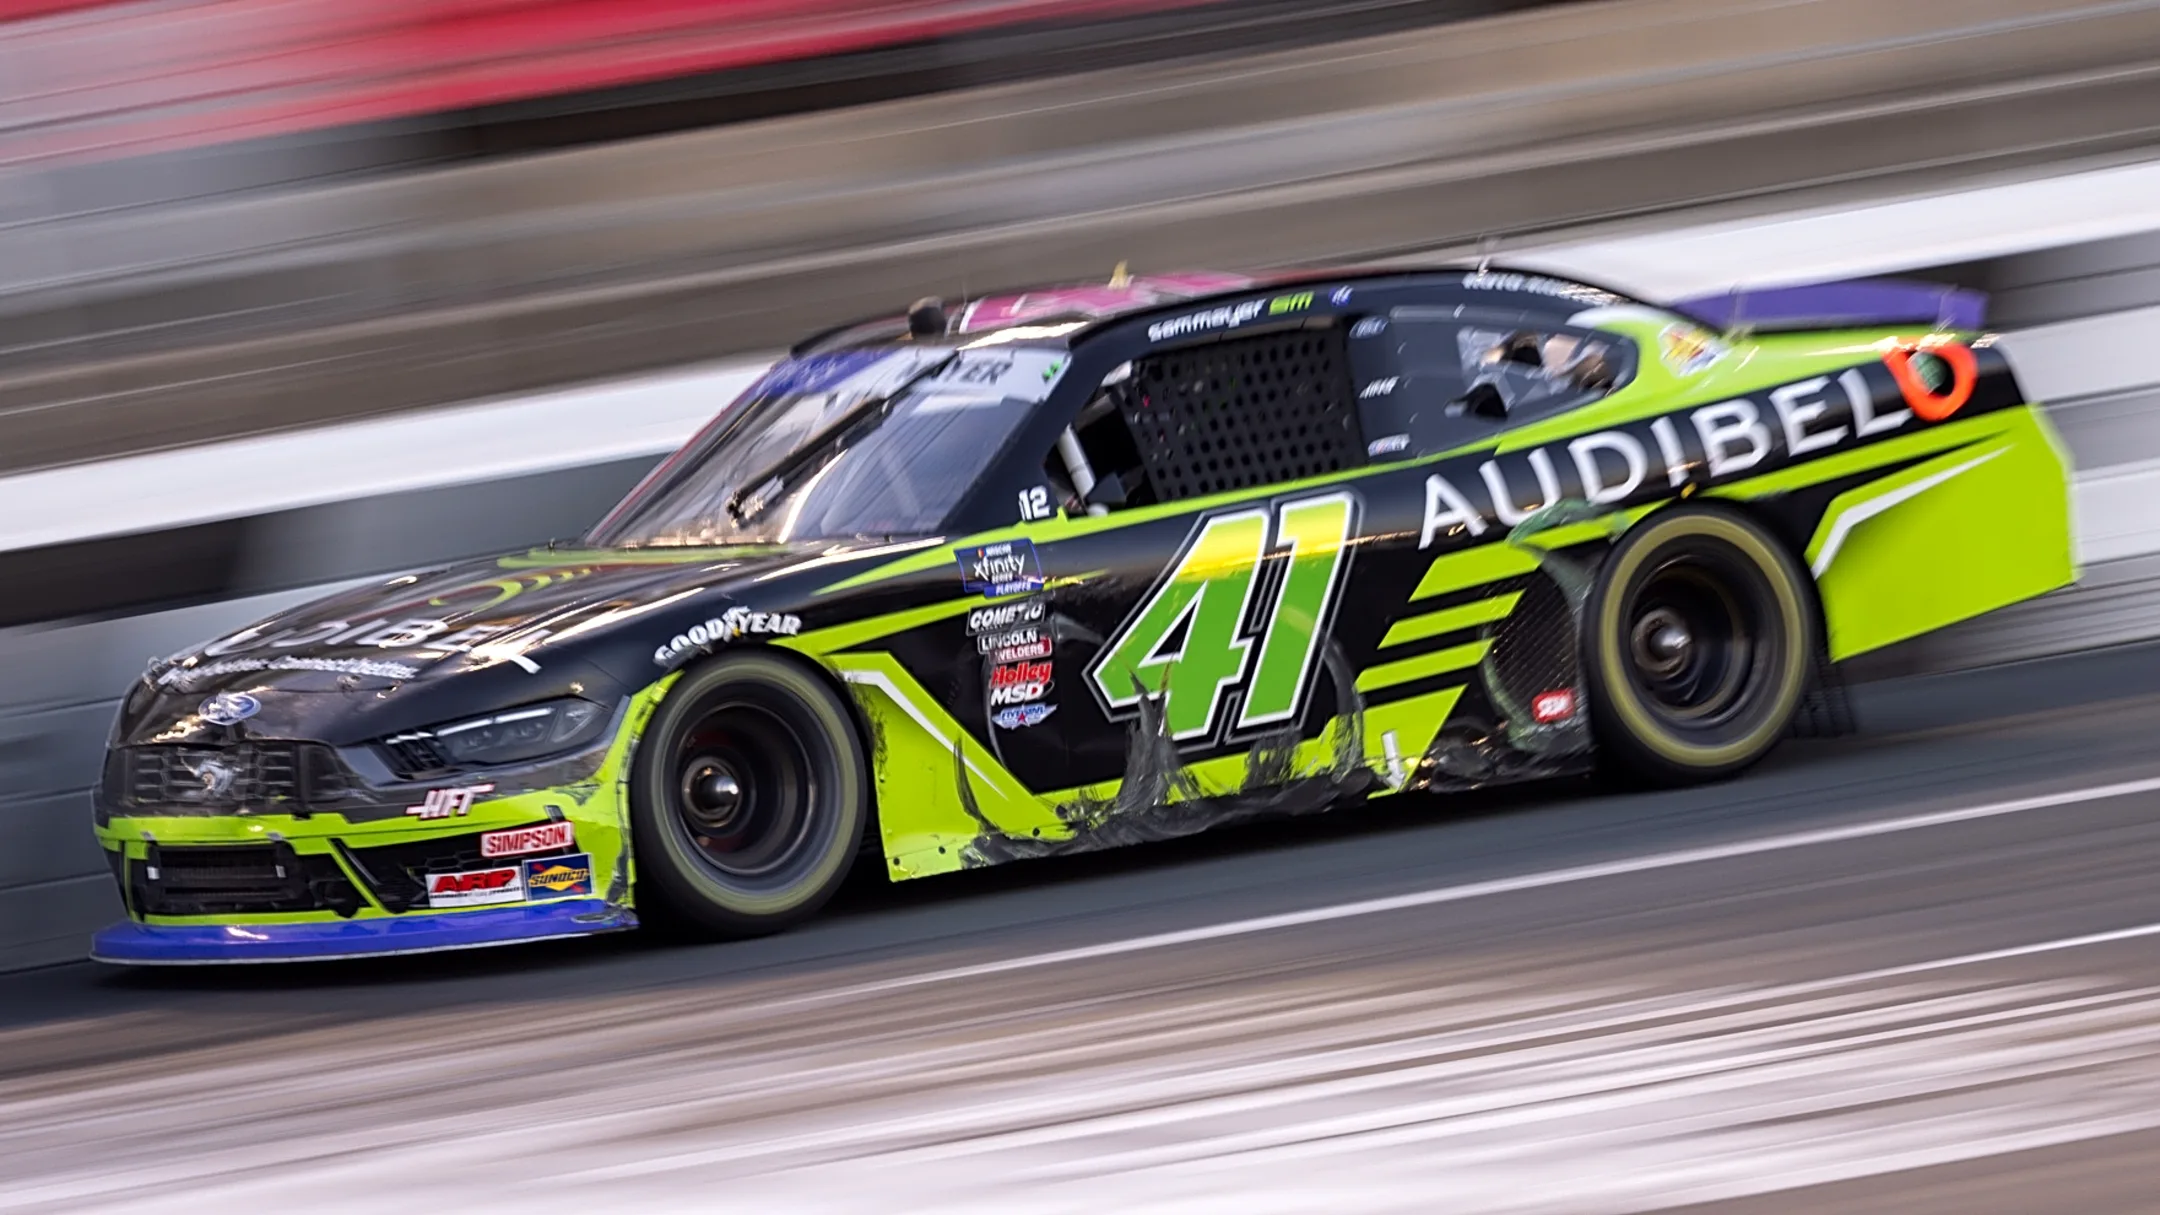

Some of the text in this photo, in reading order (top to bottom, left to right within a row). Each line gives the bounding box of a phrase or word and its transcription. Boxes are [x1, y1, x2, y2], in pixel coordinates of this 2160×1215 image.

[1417, 367, 1912, 550] AUDIBEL
[1018, 485, 1050, 521] 12
[973, 553, 1025, 581] xfinity
[1092, 490, 1356, 741] 41
[653, 605, 802, 660] GOODYEAR
[980, 629, 1037, 652] LINCOLN
[995, 643, 1045, 661] WELDERS
[990, 660, 1053, 687] Holley
[990, 681, 1044, 706] MSD
[486, 825, 567, 854] SIMPSON
[431, 868, 517, 894] ARP
[529, 870, 588, 887] SUNOCO
